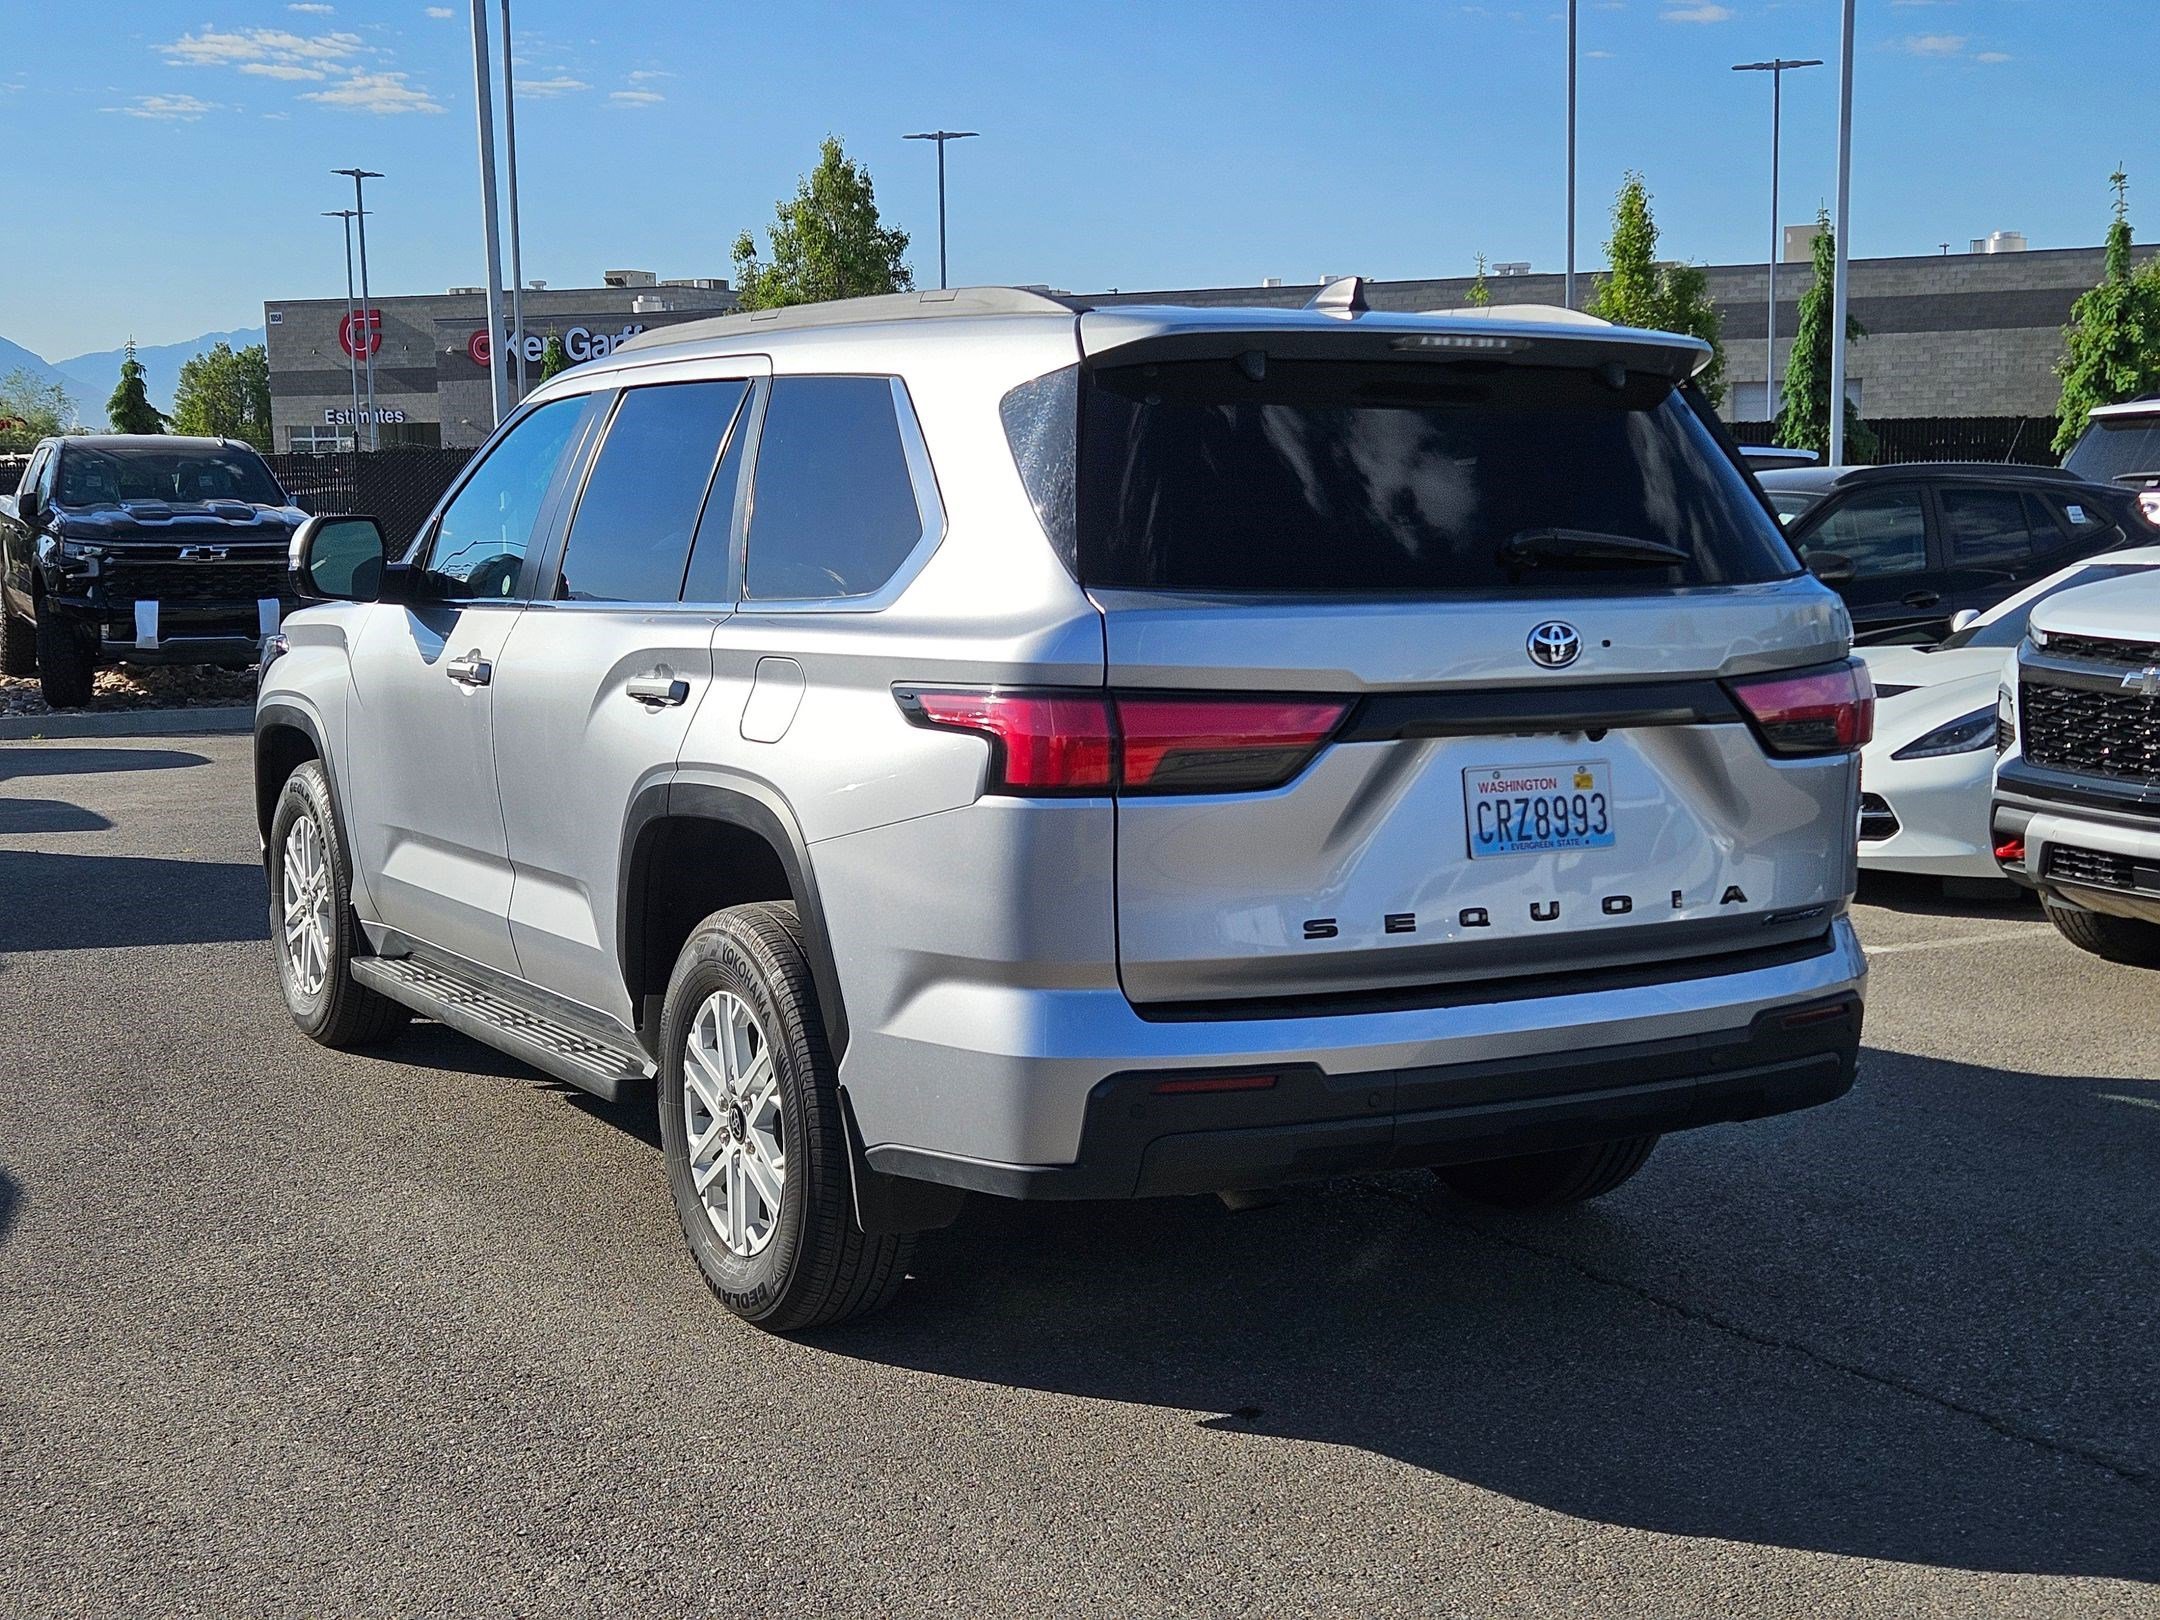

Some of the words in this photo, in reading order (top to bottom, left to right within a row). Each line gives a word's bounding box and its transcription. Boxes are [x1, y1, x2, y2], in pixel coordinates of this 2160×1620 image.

[1478, 778, 1557, 793] WASHINGTON
[1477, 793, 1608, 844] CRZ8993
[1511, 840, 1554, 851] EVERGREEN
[1557, 838, 1580, 848] STATE
[1303, 885, 1748, 940] SEQUOIA
[722, 943, 771, 1028] YOKOHAMA
